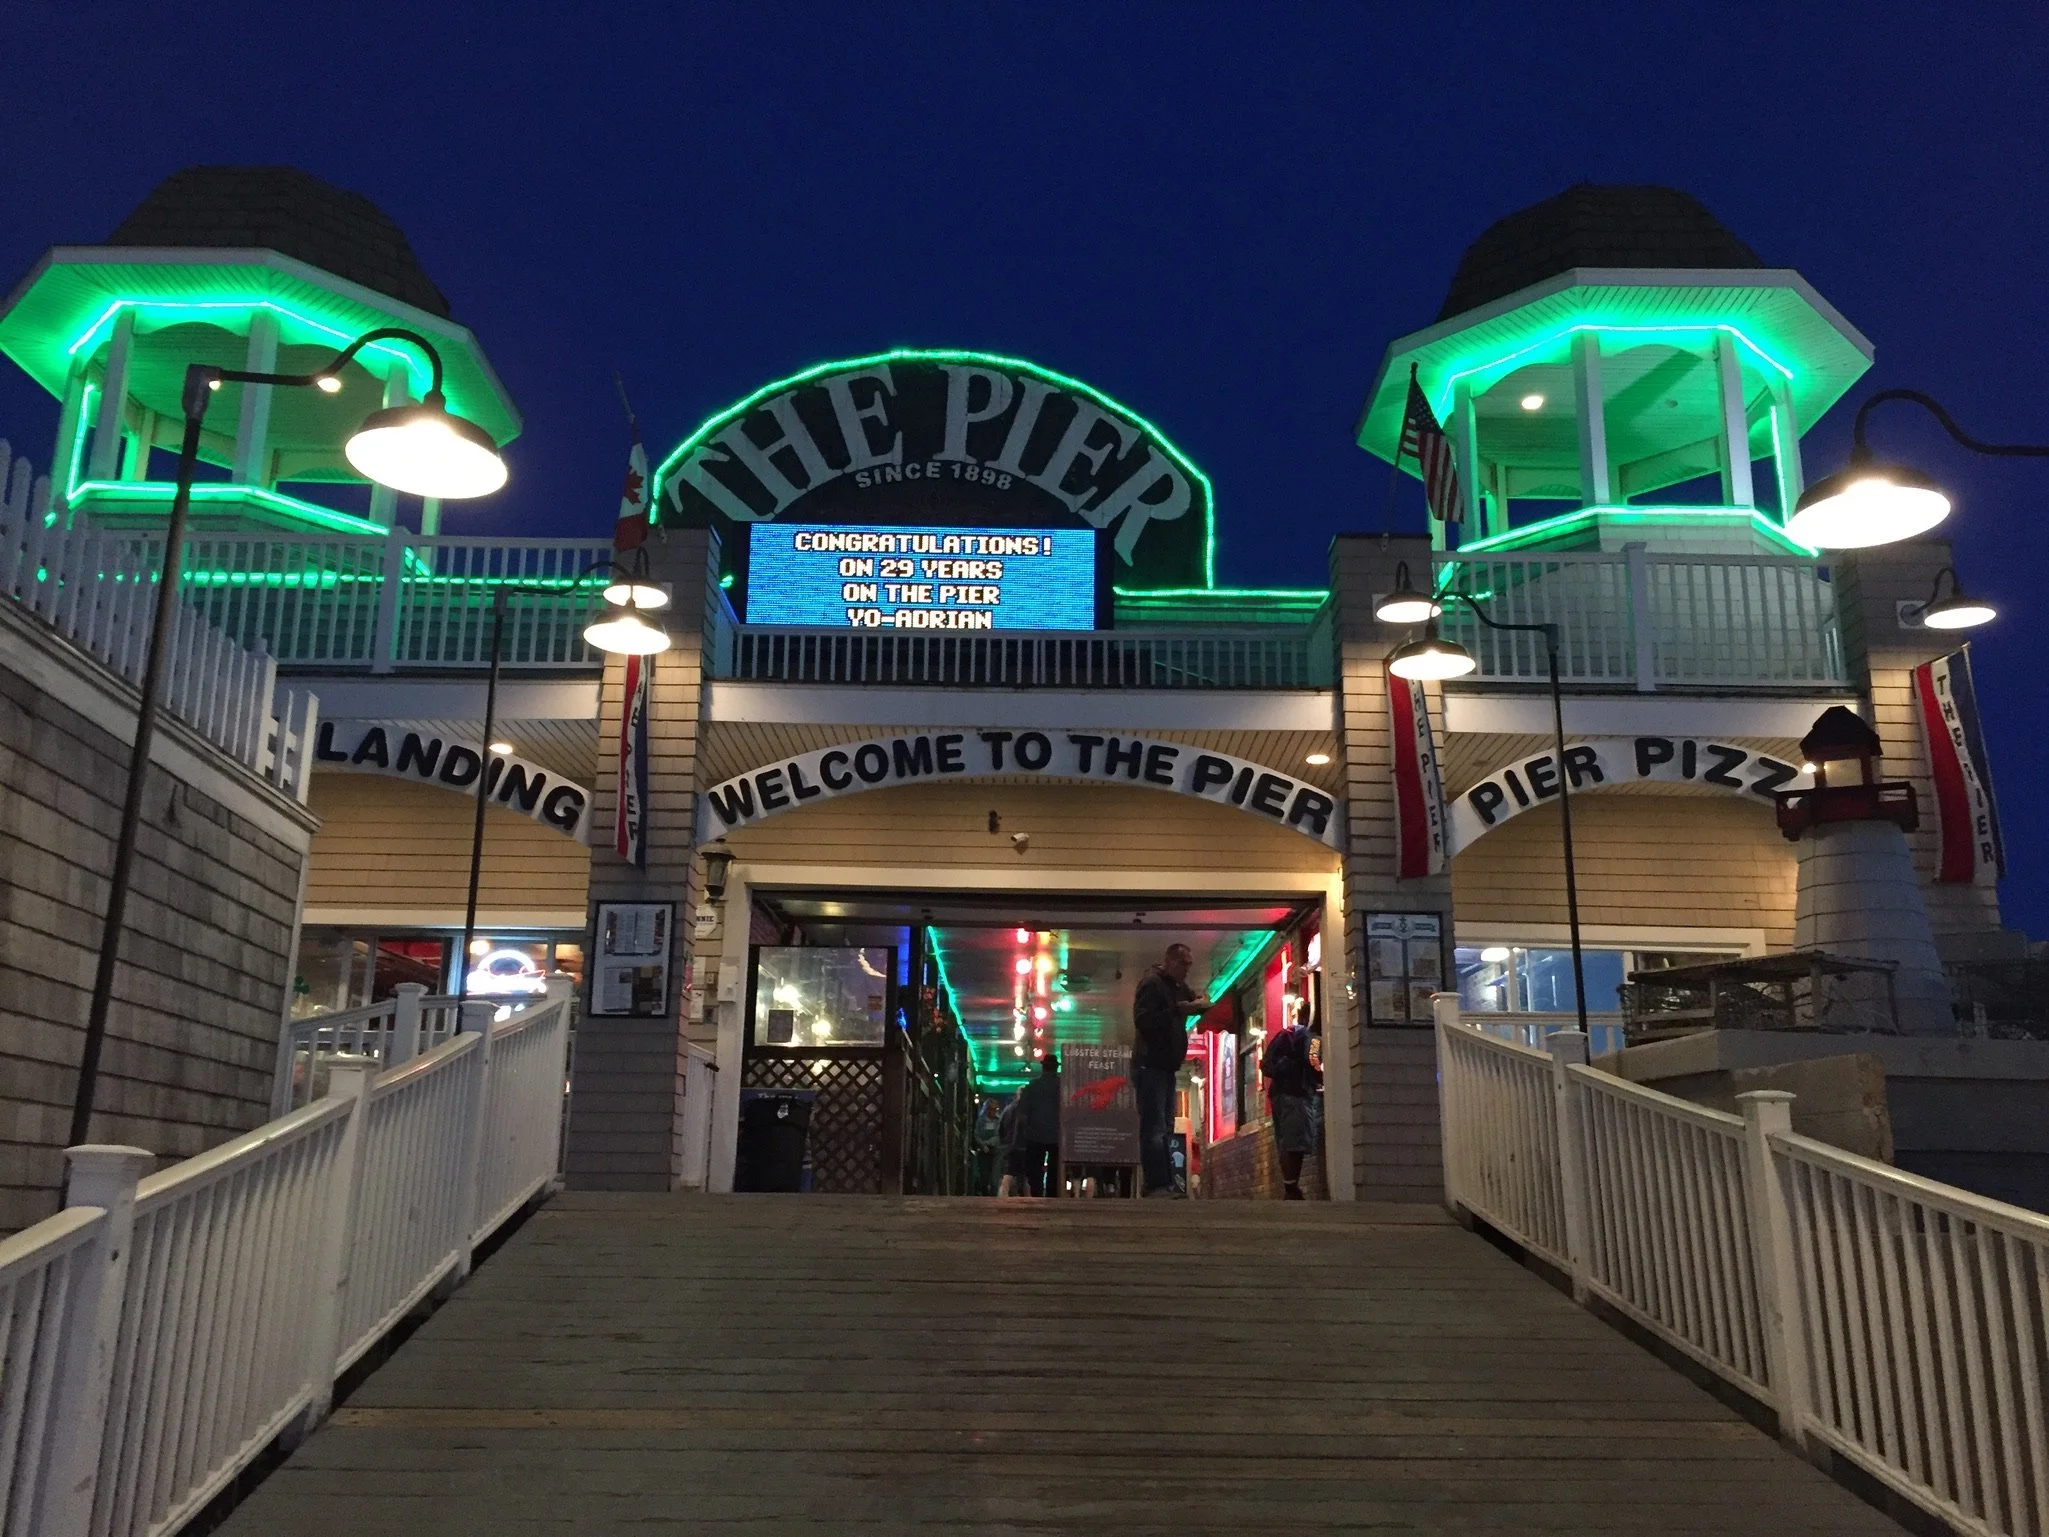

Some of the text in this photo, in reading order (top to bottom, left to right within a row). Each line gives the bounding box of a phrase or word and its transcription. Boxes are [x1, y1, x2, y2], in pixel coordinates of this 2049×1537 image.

[663, 363, 1192, 567] THE PIER
[855, 461, 1013, 490] SINCE 1898
[794, 531, 1052, 556] CONGRATULATIONS!
[839, 558, 1003, 580] ON 29 YEARS
[843, 583, 999, 605] ON THE PIER
[847, 607, 992, 630] YO-ADRIAN
[316, 721, 585, 831] LANDING
[708, 730, 1335, 836] WELCOME TO THE PIER
[1468, 736, 1800, 825] PIER PIZZ
[1064, 1048, 1100, 1057] LOBSTER
[1088, 1061, 1115, 1070] FEAST
